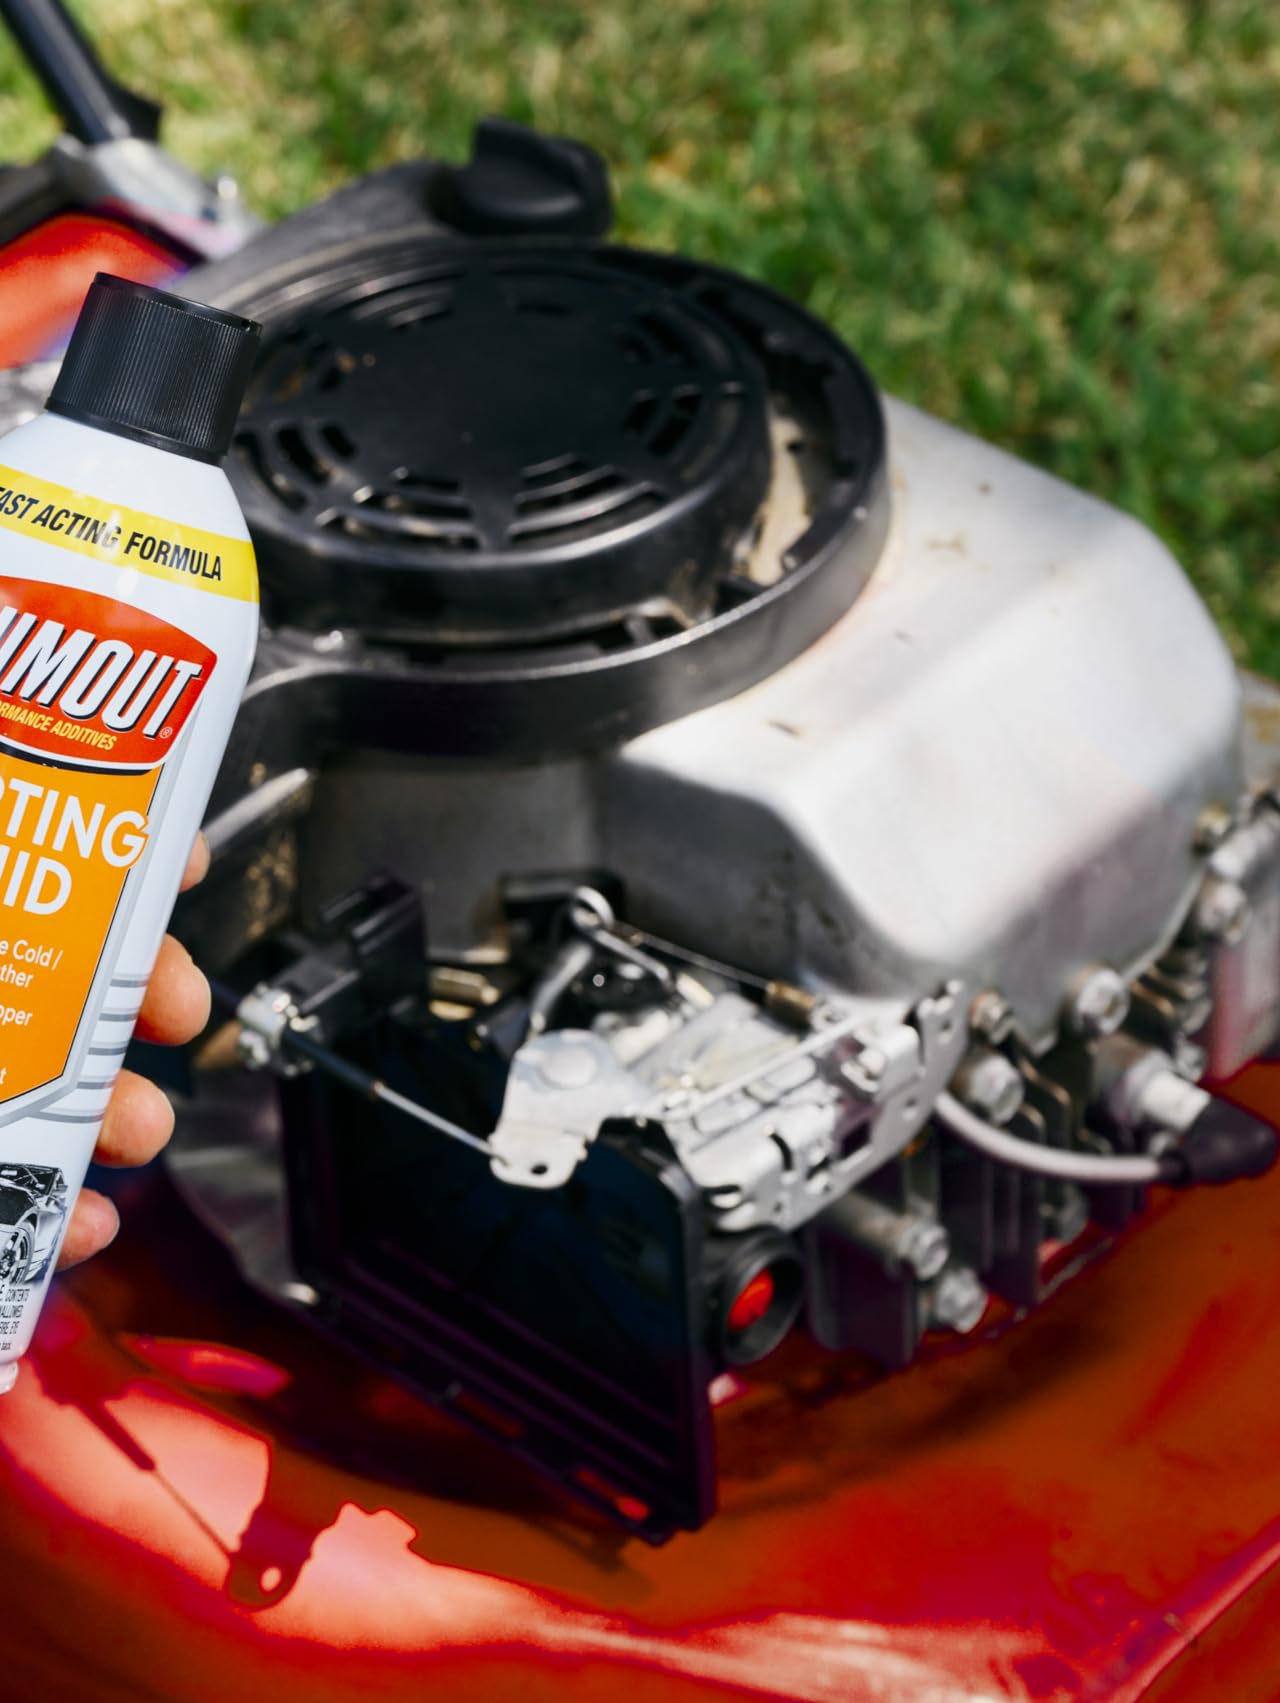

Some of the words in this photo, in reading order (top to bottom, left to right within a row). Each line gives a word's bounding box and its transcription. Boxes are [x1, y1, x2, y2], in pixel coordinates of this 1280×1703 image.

[32, 504, 122, 550] ACTING
[123, 531, 222, 581] FORMULA
[50, 719, 117, 750] ADDITIVES
[12, 939, 55, 967] Cold
